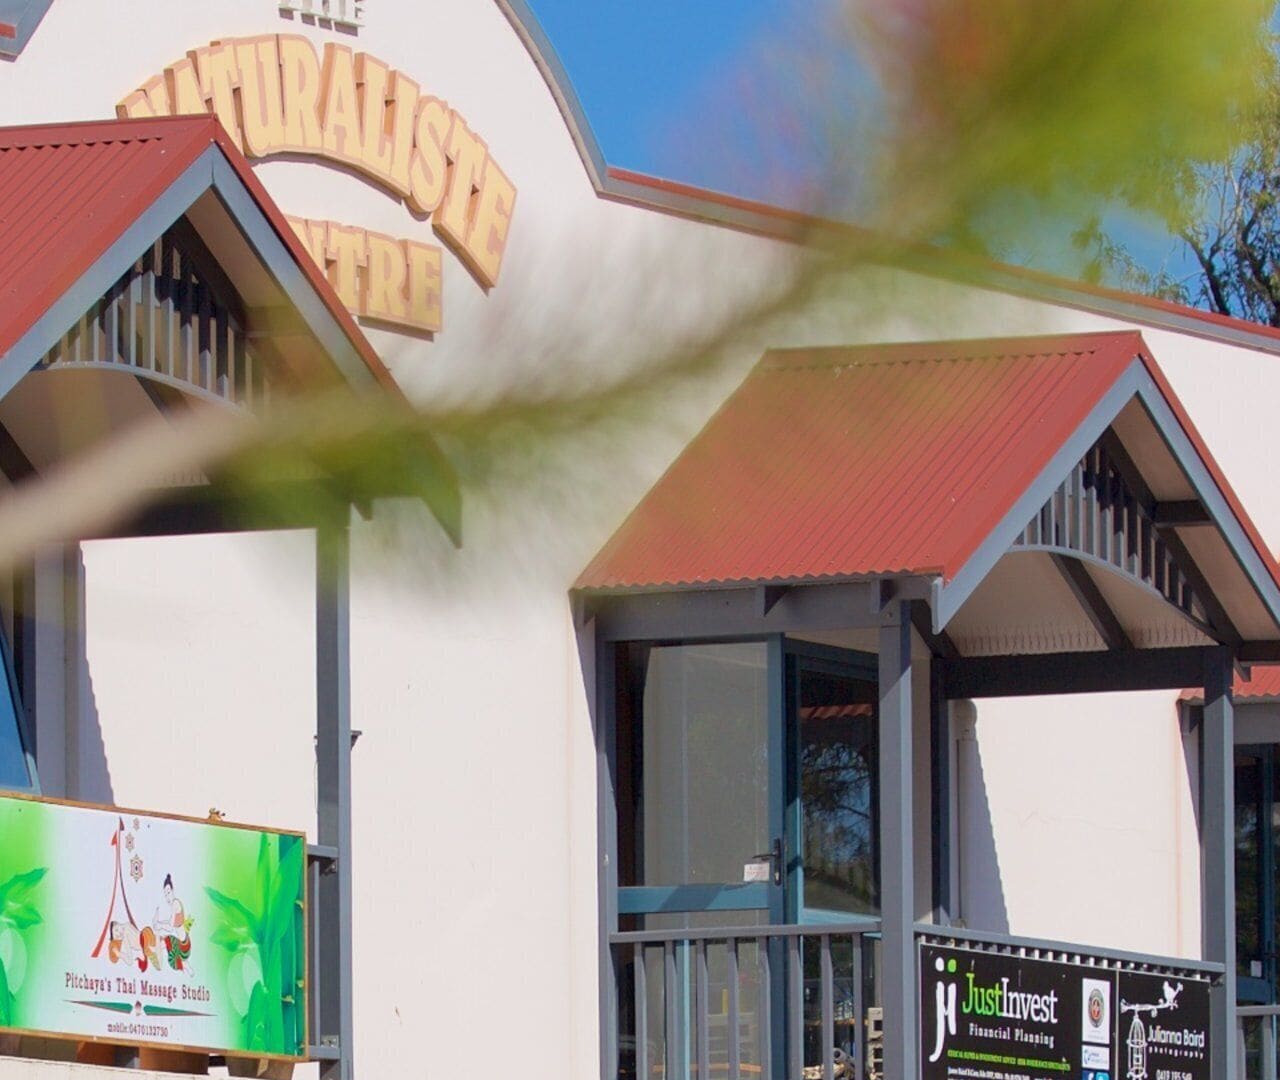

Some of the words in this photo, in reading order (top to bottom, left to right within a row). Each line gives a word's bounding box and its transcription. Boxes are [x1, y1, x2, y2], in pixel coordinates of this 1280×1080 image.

[65, 971, 113, 996] Pitchaya's
[116, 977, 136, 996] Thai
[140, 979, 178, 1003] Massage
[182, 983, 211, 1002] Studio
[962, 972, 1059, 1025] JustInvest
[968, 1022, 1012, 1041] Financial
[1014, 1028, 1056, 1050] Planning
[1183, 1028, 1205, 1048] Baird
[1148, 1045, 1204, 1060] photography
